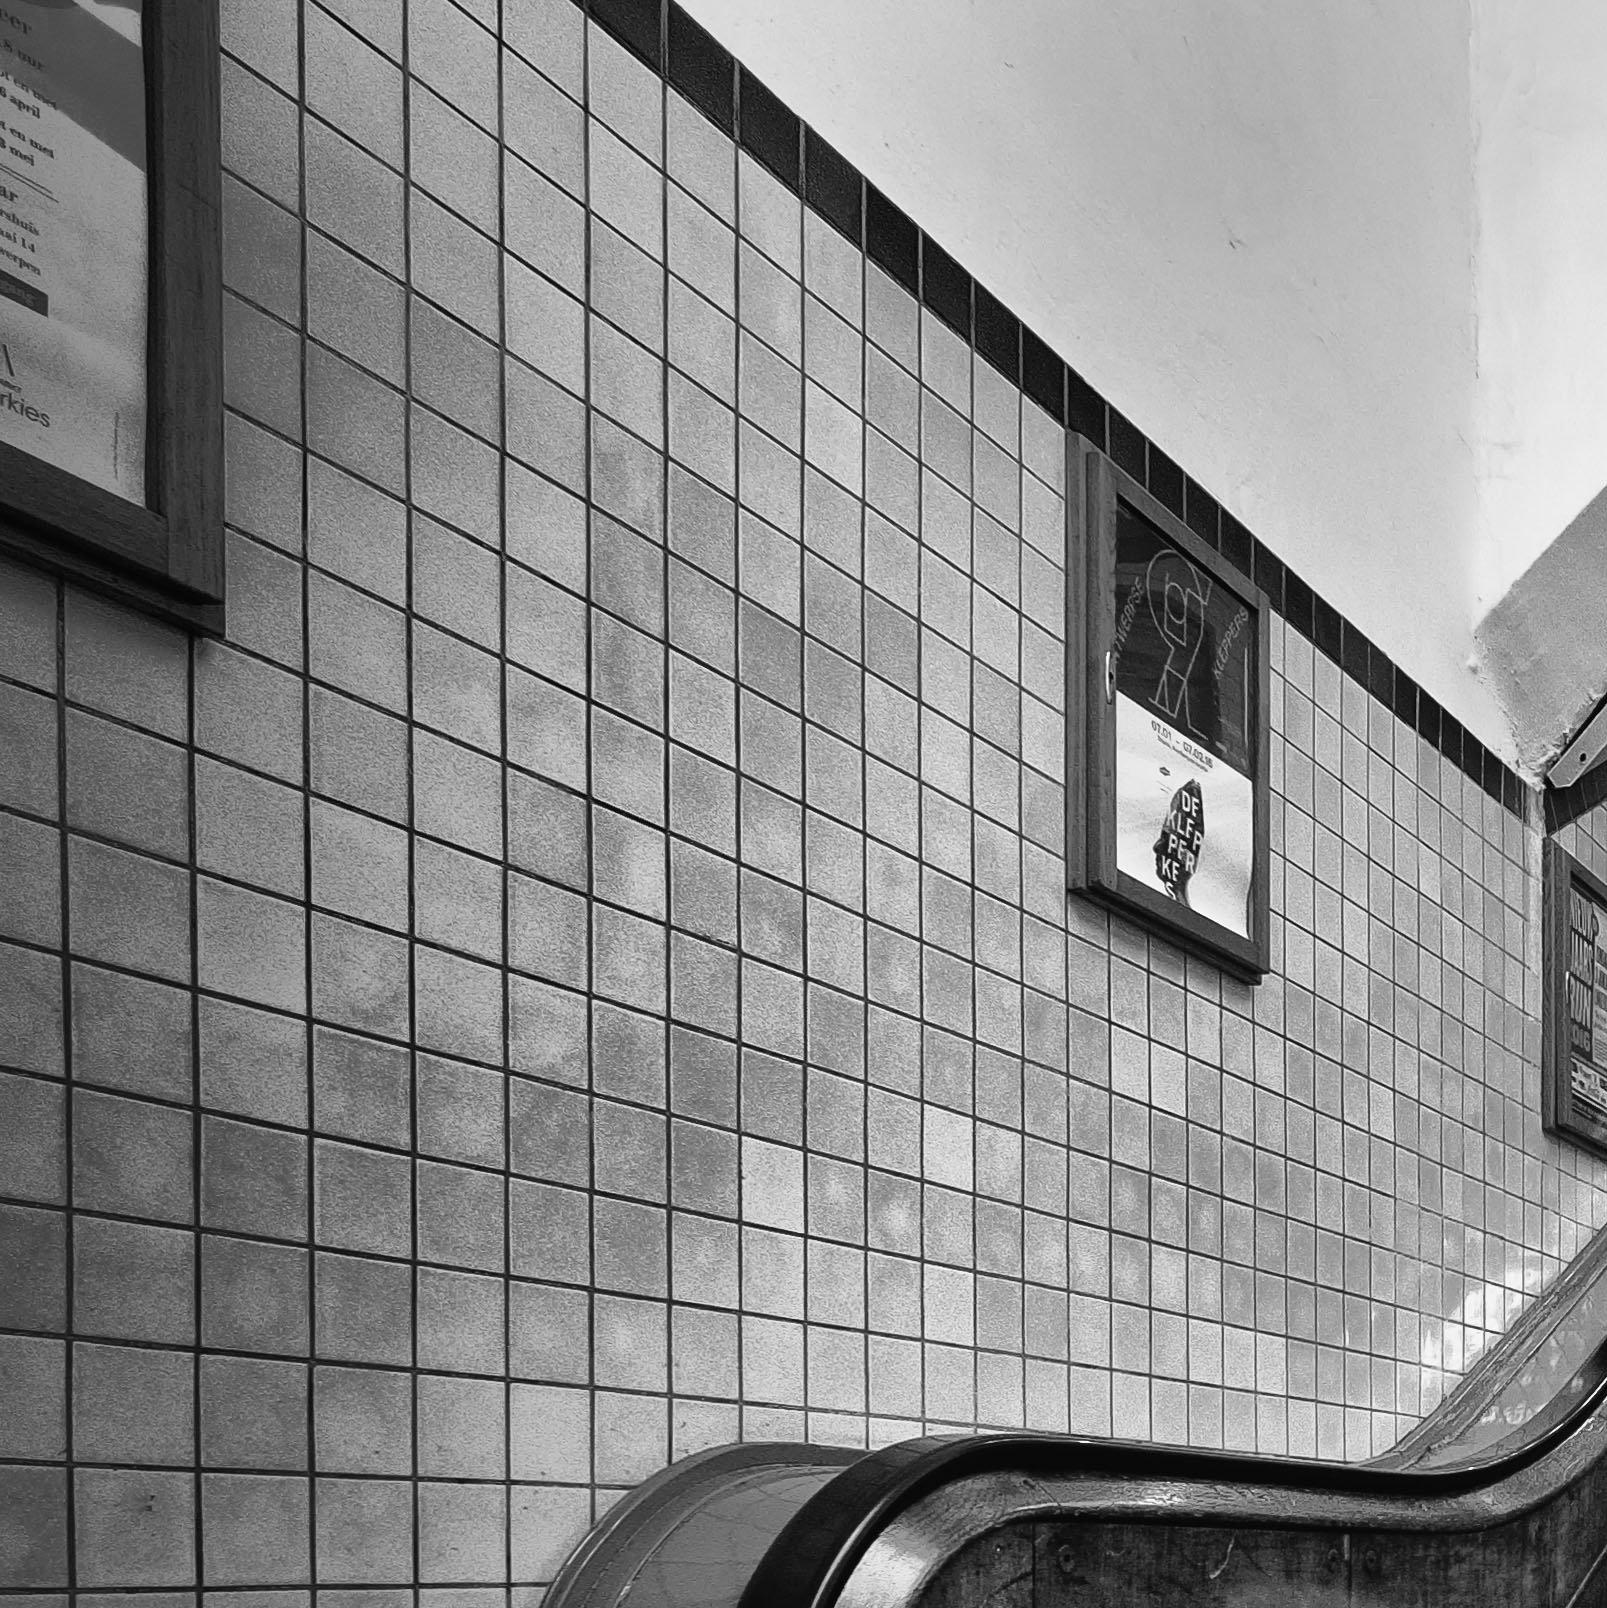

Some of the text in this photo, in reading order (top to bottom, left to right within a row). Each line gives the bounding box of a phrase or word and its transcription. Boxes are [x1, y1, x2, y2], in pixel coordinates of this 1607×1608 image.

[1211, 604, 1249, 681] KLEPPERS
[1181, 790, 1200, 818] DE
[1161, 855, 1180, 883] KE
[1167, 833, 1195, 874] PER
